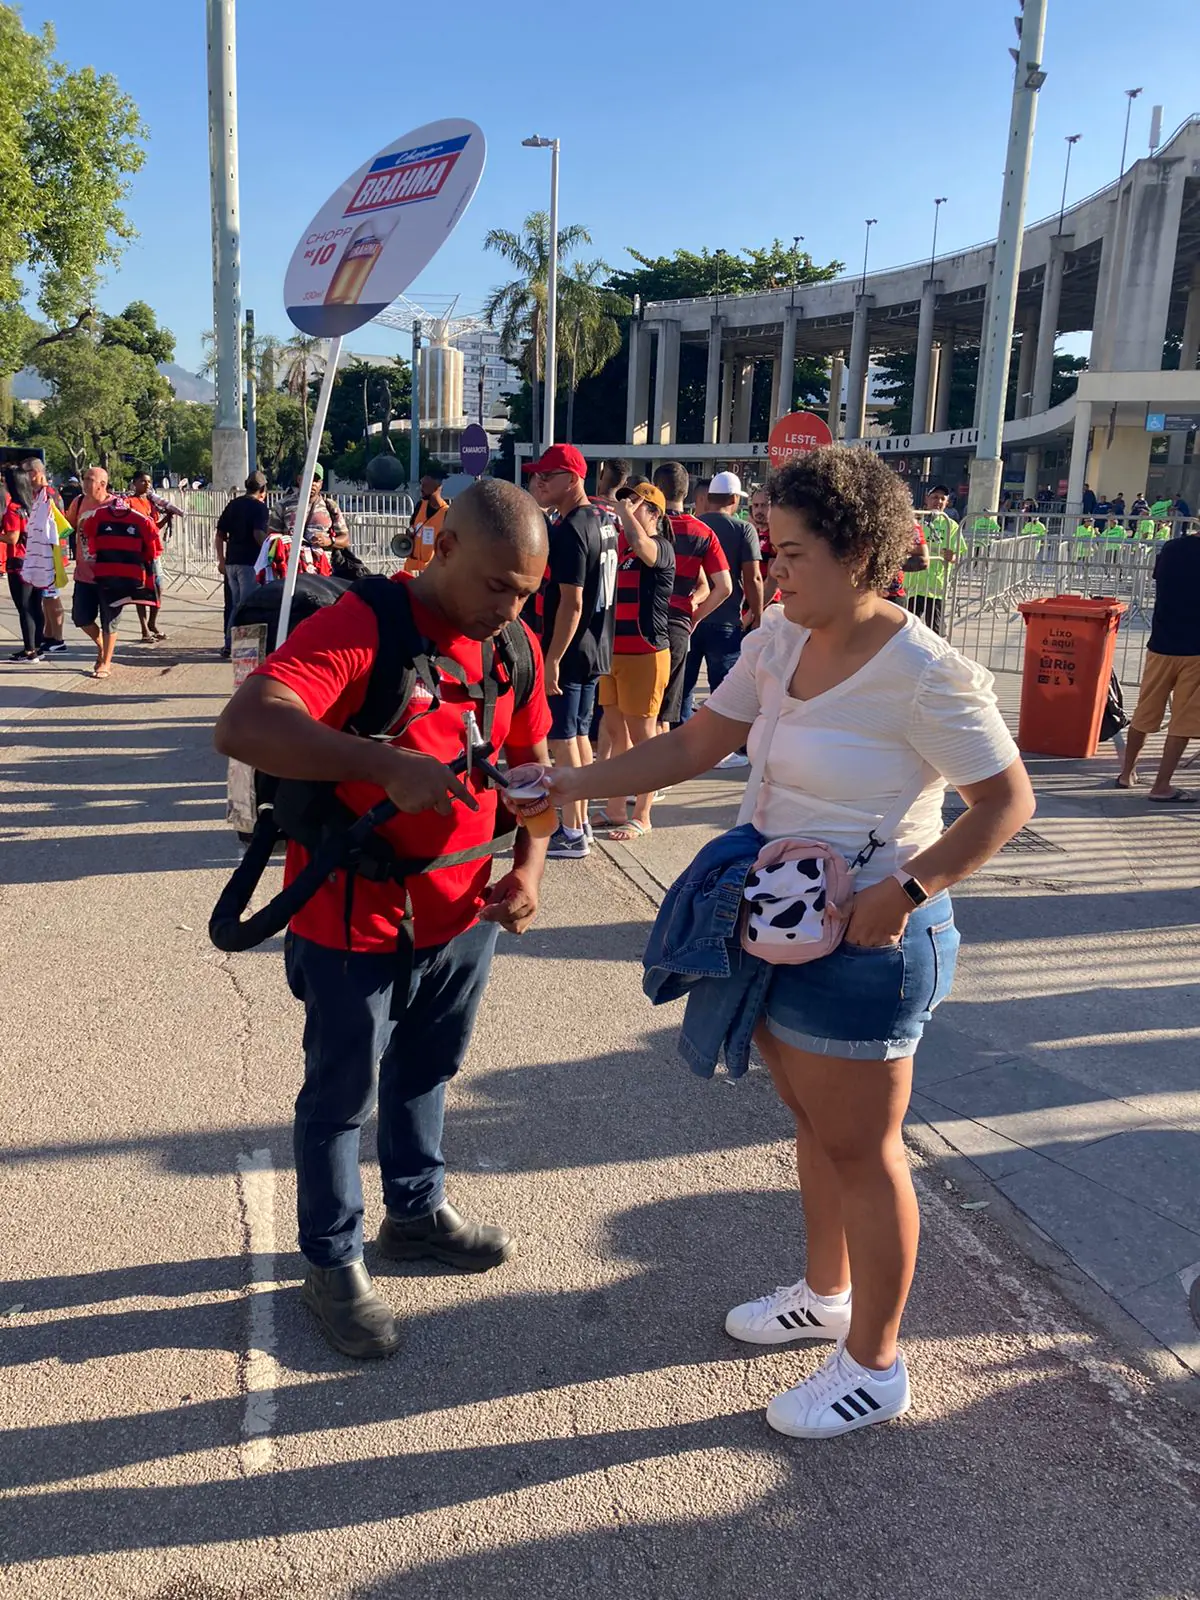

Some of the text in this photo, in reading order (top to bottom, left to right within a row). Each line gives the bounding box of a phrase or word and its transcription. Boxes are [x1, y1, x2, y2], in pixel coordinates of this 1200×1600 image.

[352, 160, 449, 208] BRAHMA
[306, 227, 352, 244] CHOPP
[785, 433, 817, 445] LESTE
[462, 446, 487, 454] CAMAROTE
[771, 446, 811, 459] SUPER
[733, 463, 740, 474] D
[899, 461, 906, 473] D
[1049, 628, 1072, 638] Lixo
[1052, 639, 1074, 648] aqui
[1054, 659, 1075, 670] Rio
